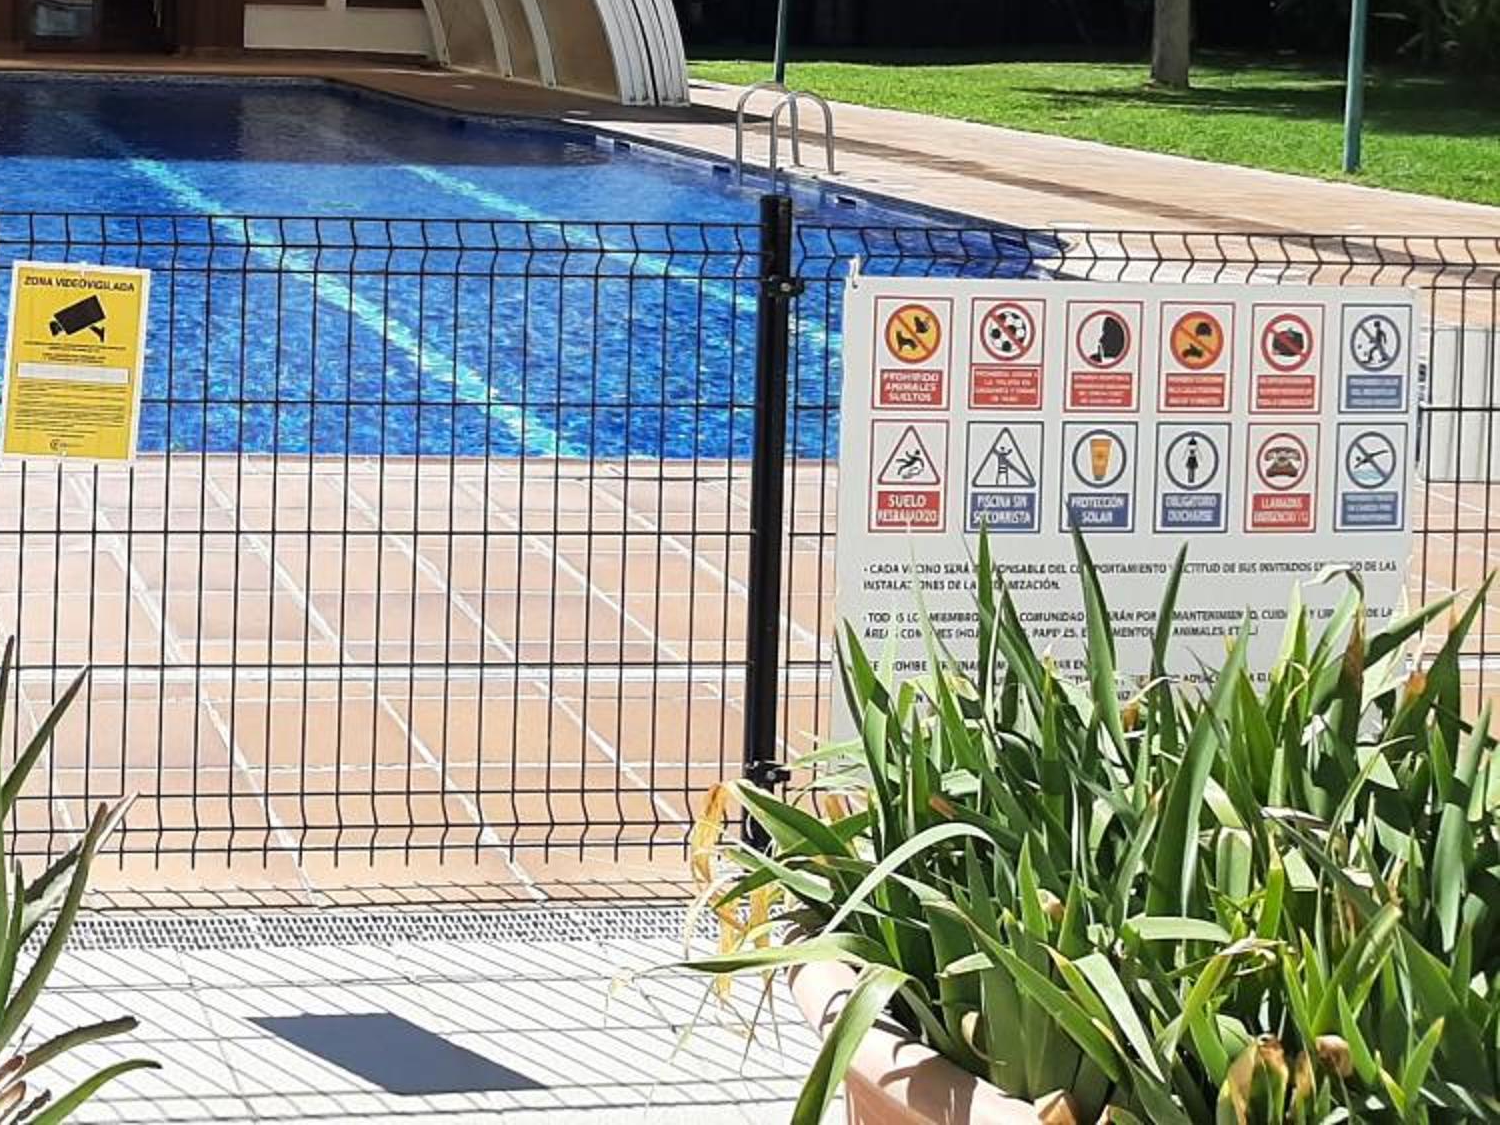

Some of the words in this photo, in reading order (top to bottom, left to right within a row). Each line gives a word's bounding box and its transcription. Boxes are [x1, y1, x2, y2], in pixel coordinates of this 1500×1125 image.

[24, 277, 53, 286] ZONA
[884, 383, 937, 391] ANIMALES
[888, 392, 932, 402] SUELTOS
[888, 494, 926, 507] SUELO
[977, 495, 1010, 508] PISCINA
[1012, 495, 1027, 508] SIN
[1081, 510, 1113, 523] SOLAR
[869, 563, 899, 574] CADA
[943, 561, 969, 574] SERÁ
[1047, 564, 1067, 574] DEL
[1222, 562, 1235, 573] DE
[1238, 562, 1257, 572] SUS
[1259, 562, 1312, 572] INVITADOS
[1364, 560, 1377, 572] DE
[1378, 560, 1397, 572] LAS
[947, 580, 962, 590] DE
[963, 580, 977, 590] LA
[929, 611, 980, 622] MIEMBRO
[1019, 611, 1085, 622] COMUNIDAD
[1137, 611, 1157, 622] POR
